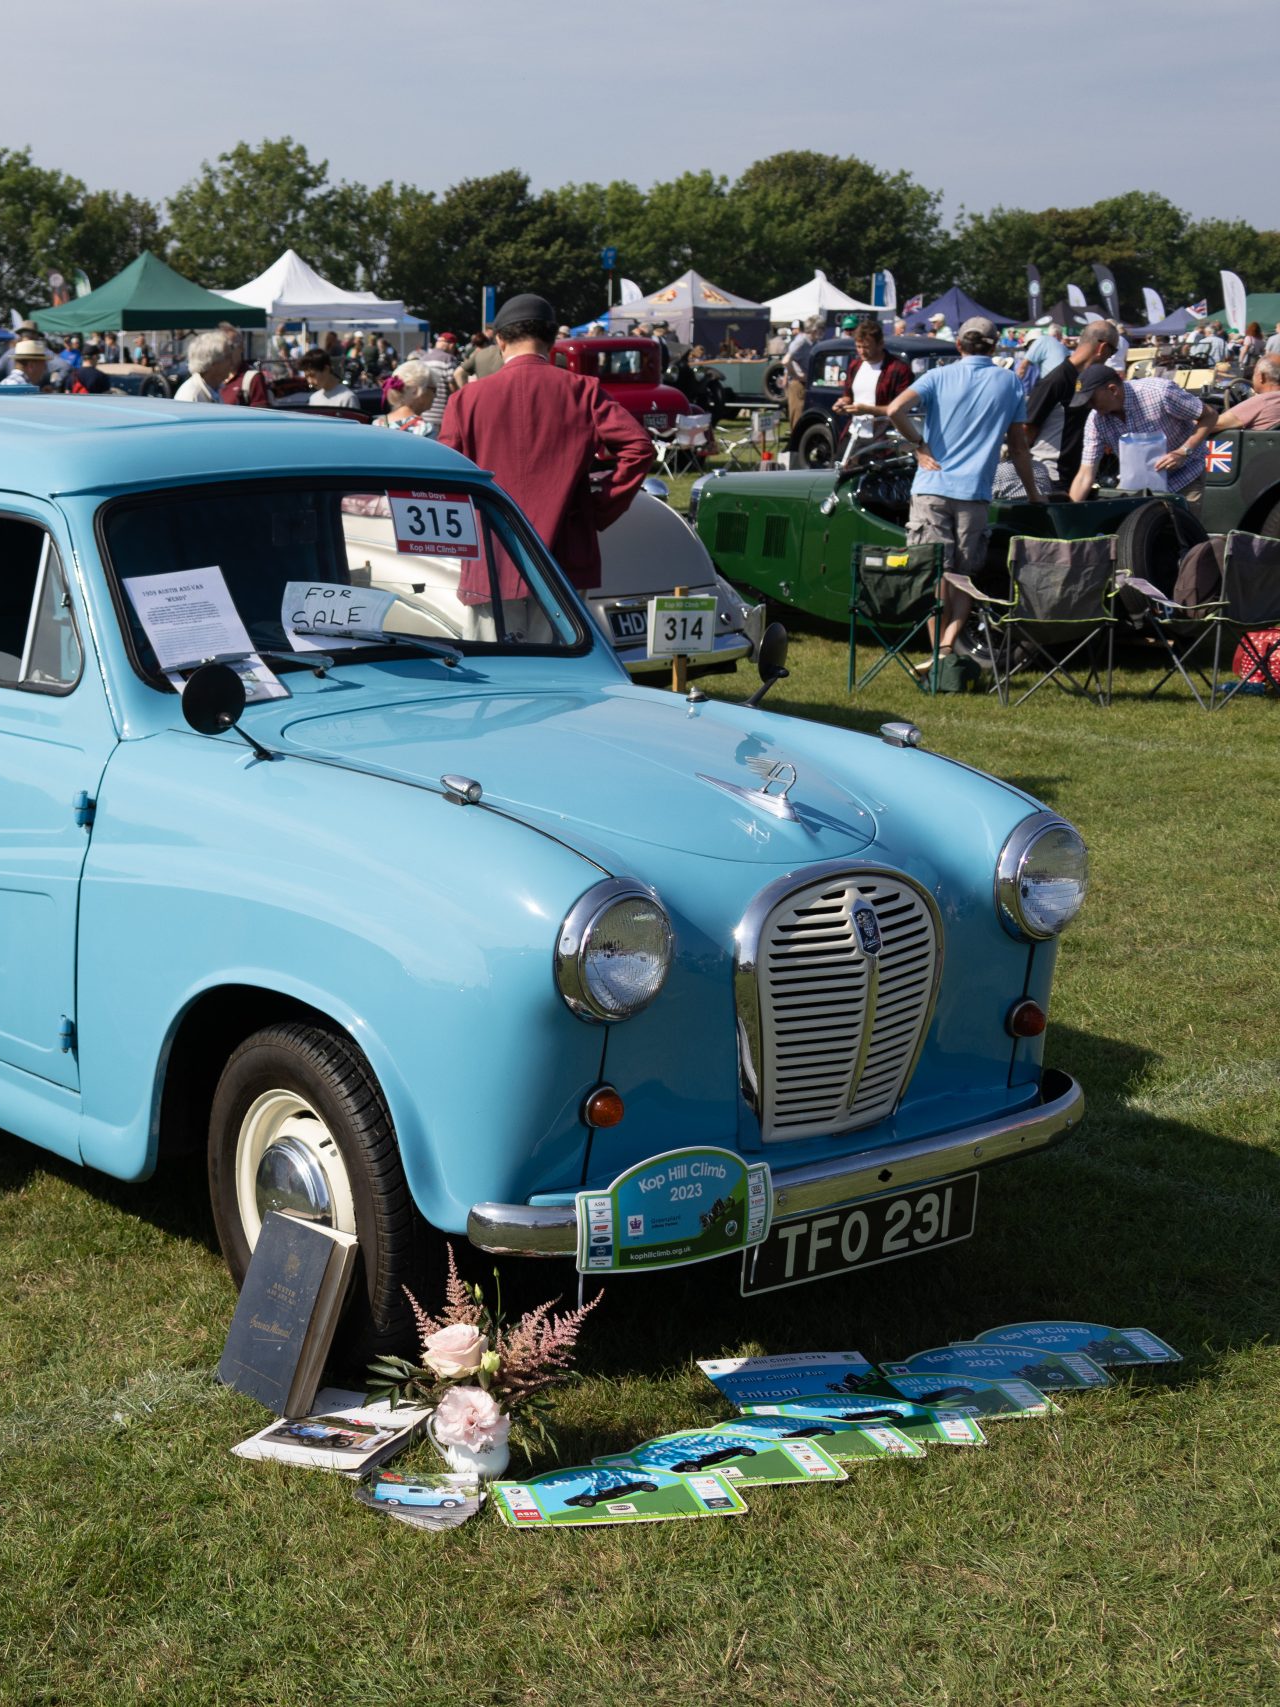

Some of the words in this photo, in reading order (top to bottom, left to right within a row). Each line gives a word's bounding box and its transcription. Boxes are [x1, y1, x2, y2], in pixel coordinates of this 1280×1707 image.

[406, 505, 462, 538] 315
[409, 544, 424, 553] Kop
[425, 544, 436, 553] Hill
[437, 545, 457, 554] Climb
[158, 587, 178, 595] AUSTIN
[305, 587, 352, 600] FOR
[291, 606, 367, 629] SALE
[665, 616, 704, 641] 314
[638, 1174, 666, 1193] Kop
[668, 1162, 688, 1182] Hill
[690, 1162, 727, 1179] Climb
[670, 1183, 703, 1202] 2023
[778, 1210, 869, 1278] TFO
[882, 1187, 953, 1254] 231
[630, 1245, 691, 1261] kophillclimb.org.uk
[998, 1331, 1023, 1341] Kop
[1025, 1327, 1042, 1336] Hill
[1045, 1326, 1090, 1334] Climb
[1032, 1335, 1069, 1344] 2022
[770, 1356, 797, 1364] Climb
[923, 1353, 954, 1364] Kop
[957, 1349, 979, 1358] Hill
[981, 1348, 1035, 1358] Climb
[965, 1359, 1006, 1368] 2021
[895, 1377, 920, 1387] Hill
[925, 1377, 975, 1389] Climb
[910, 1385, 942, 1393] 2019
[736, 1387, 802, 1399] Entrant
[752, 1418, 780, 1427] Hill
[783, 1418, 834, 1429] Climb
